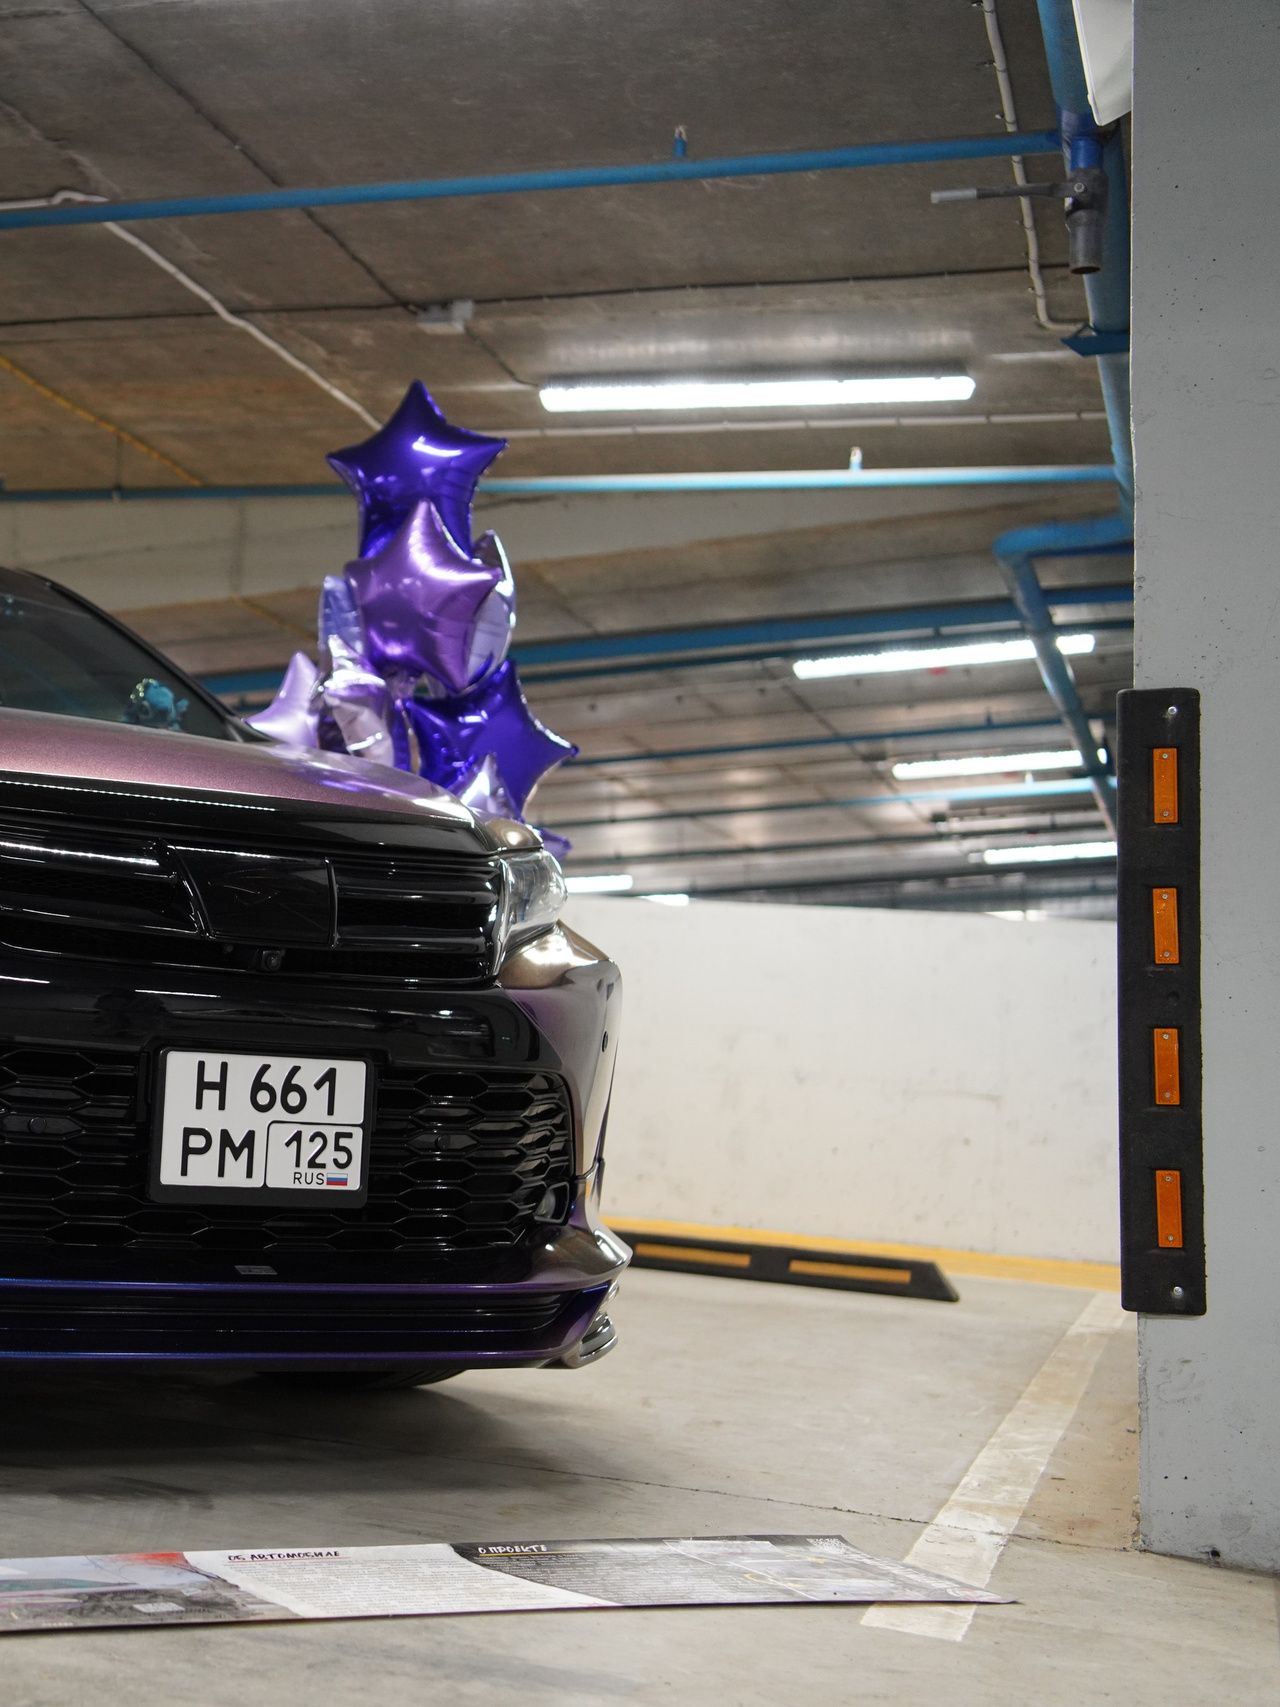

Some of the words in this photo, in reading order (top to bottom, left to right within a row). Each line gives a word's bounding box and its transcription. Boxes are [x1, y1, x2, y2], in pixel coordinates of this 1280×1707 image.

[195, 1060, 228, 1110] Н
[250, 1064, 336, 1116] 661
[180, 1127, 256, 1178] РМ
[284, 1130, 353, 1169] 125
[293, 1171, 325, 1185] RUS
[250, 1550, 340, 1561] АВТОМОБИЛЕ
[488, 1544, 547, 1554] ПРОЕКТЕ
